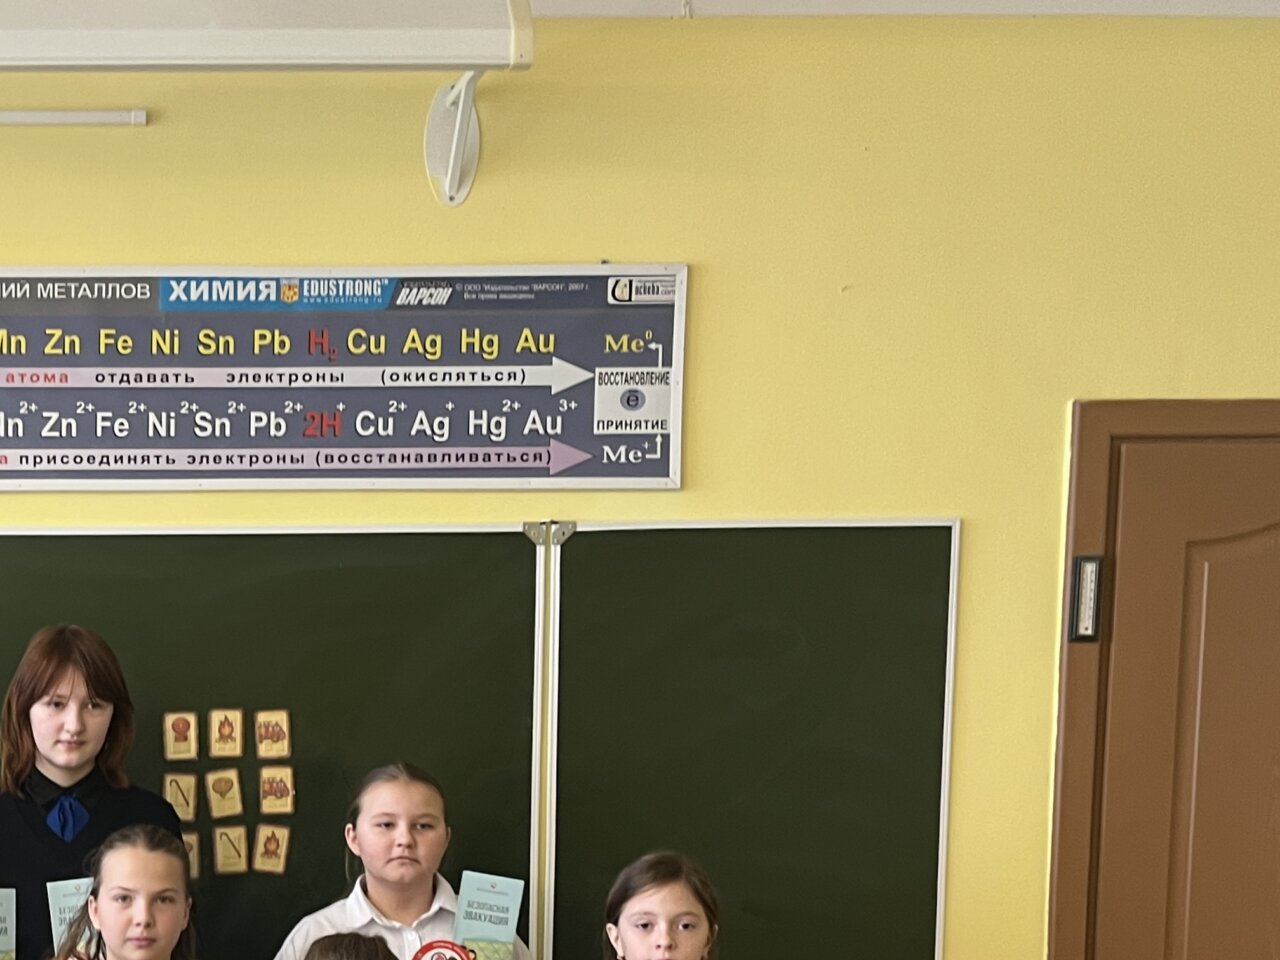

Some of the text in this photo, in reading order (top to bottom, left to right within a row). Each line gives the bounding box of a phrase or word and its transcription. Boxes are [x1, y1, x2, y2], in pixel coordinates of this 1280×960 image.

[37, 282, 151, 299] МЕТАЛЛОВ
[168, 279, 277, 302] ХИМИЯ
[396, 287, 453, 306] ВАРСОН
[43, 328, 81, 355] Zn
[98, 328, 133, 355] Fe
[151, 328, 180, 355] Ni
[197, 328, 235, 355] Sn
[253, 328, 291, 355] Pb
[347, 327, 386, 354] Cu
[402, 327, 442, 360] Ag
[460, 327, 500, 360] Hg
[515, 327, 556, 354] Au
[5, 372, 69, 383] атома
[95, 372, 196, 385] отдавать
[226, 371, 345, 386] электроны
[380, 369, 526, 386] (окисляться)
[597, 371, 670, 386] ВОССТАНОВЛЕНИЕ
[597, 419, 668, 431] ПРИНЯТИЕ
[19, 454, 176, 468] присоединять
[186, 452, 305, 467] электроны
[315, 450, 552, 468] (восстанавливаться)
[467, 900, 510, 914] БЕЗОПАСНАЯ
[463, 910, 509, 926] ЭВАКУАЦИЯ
